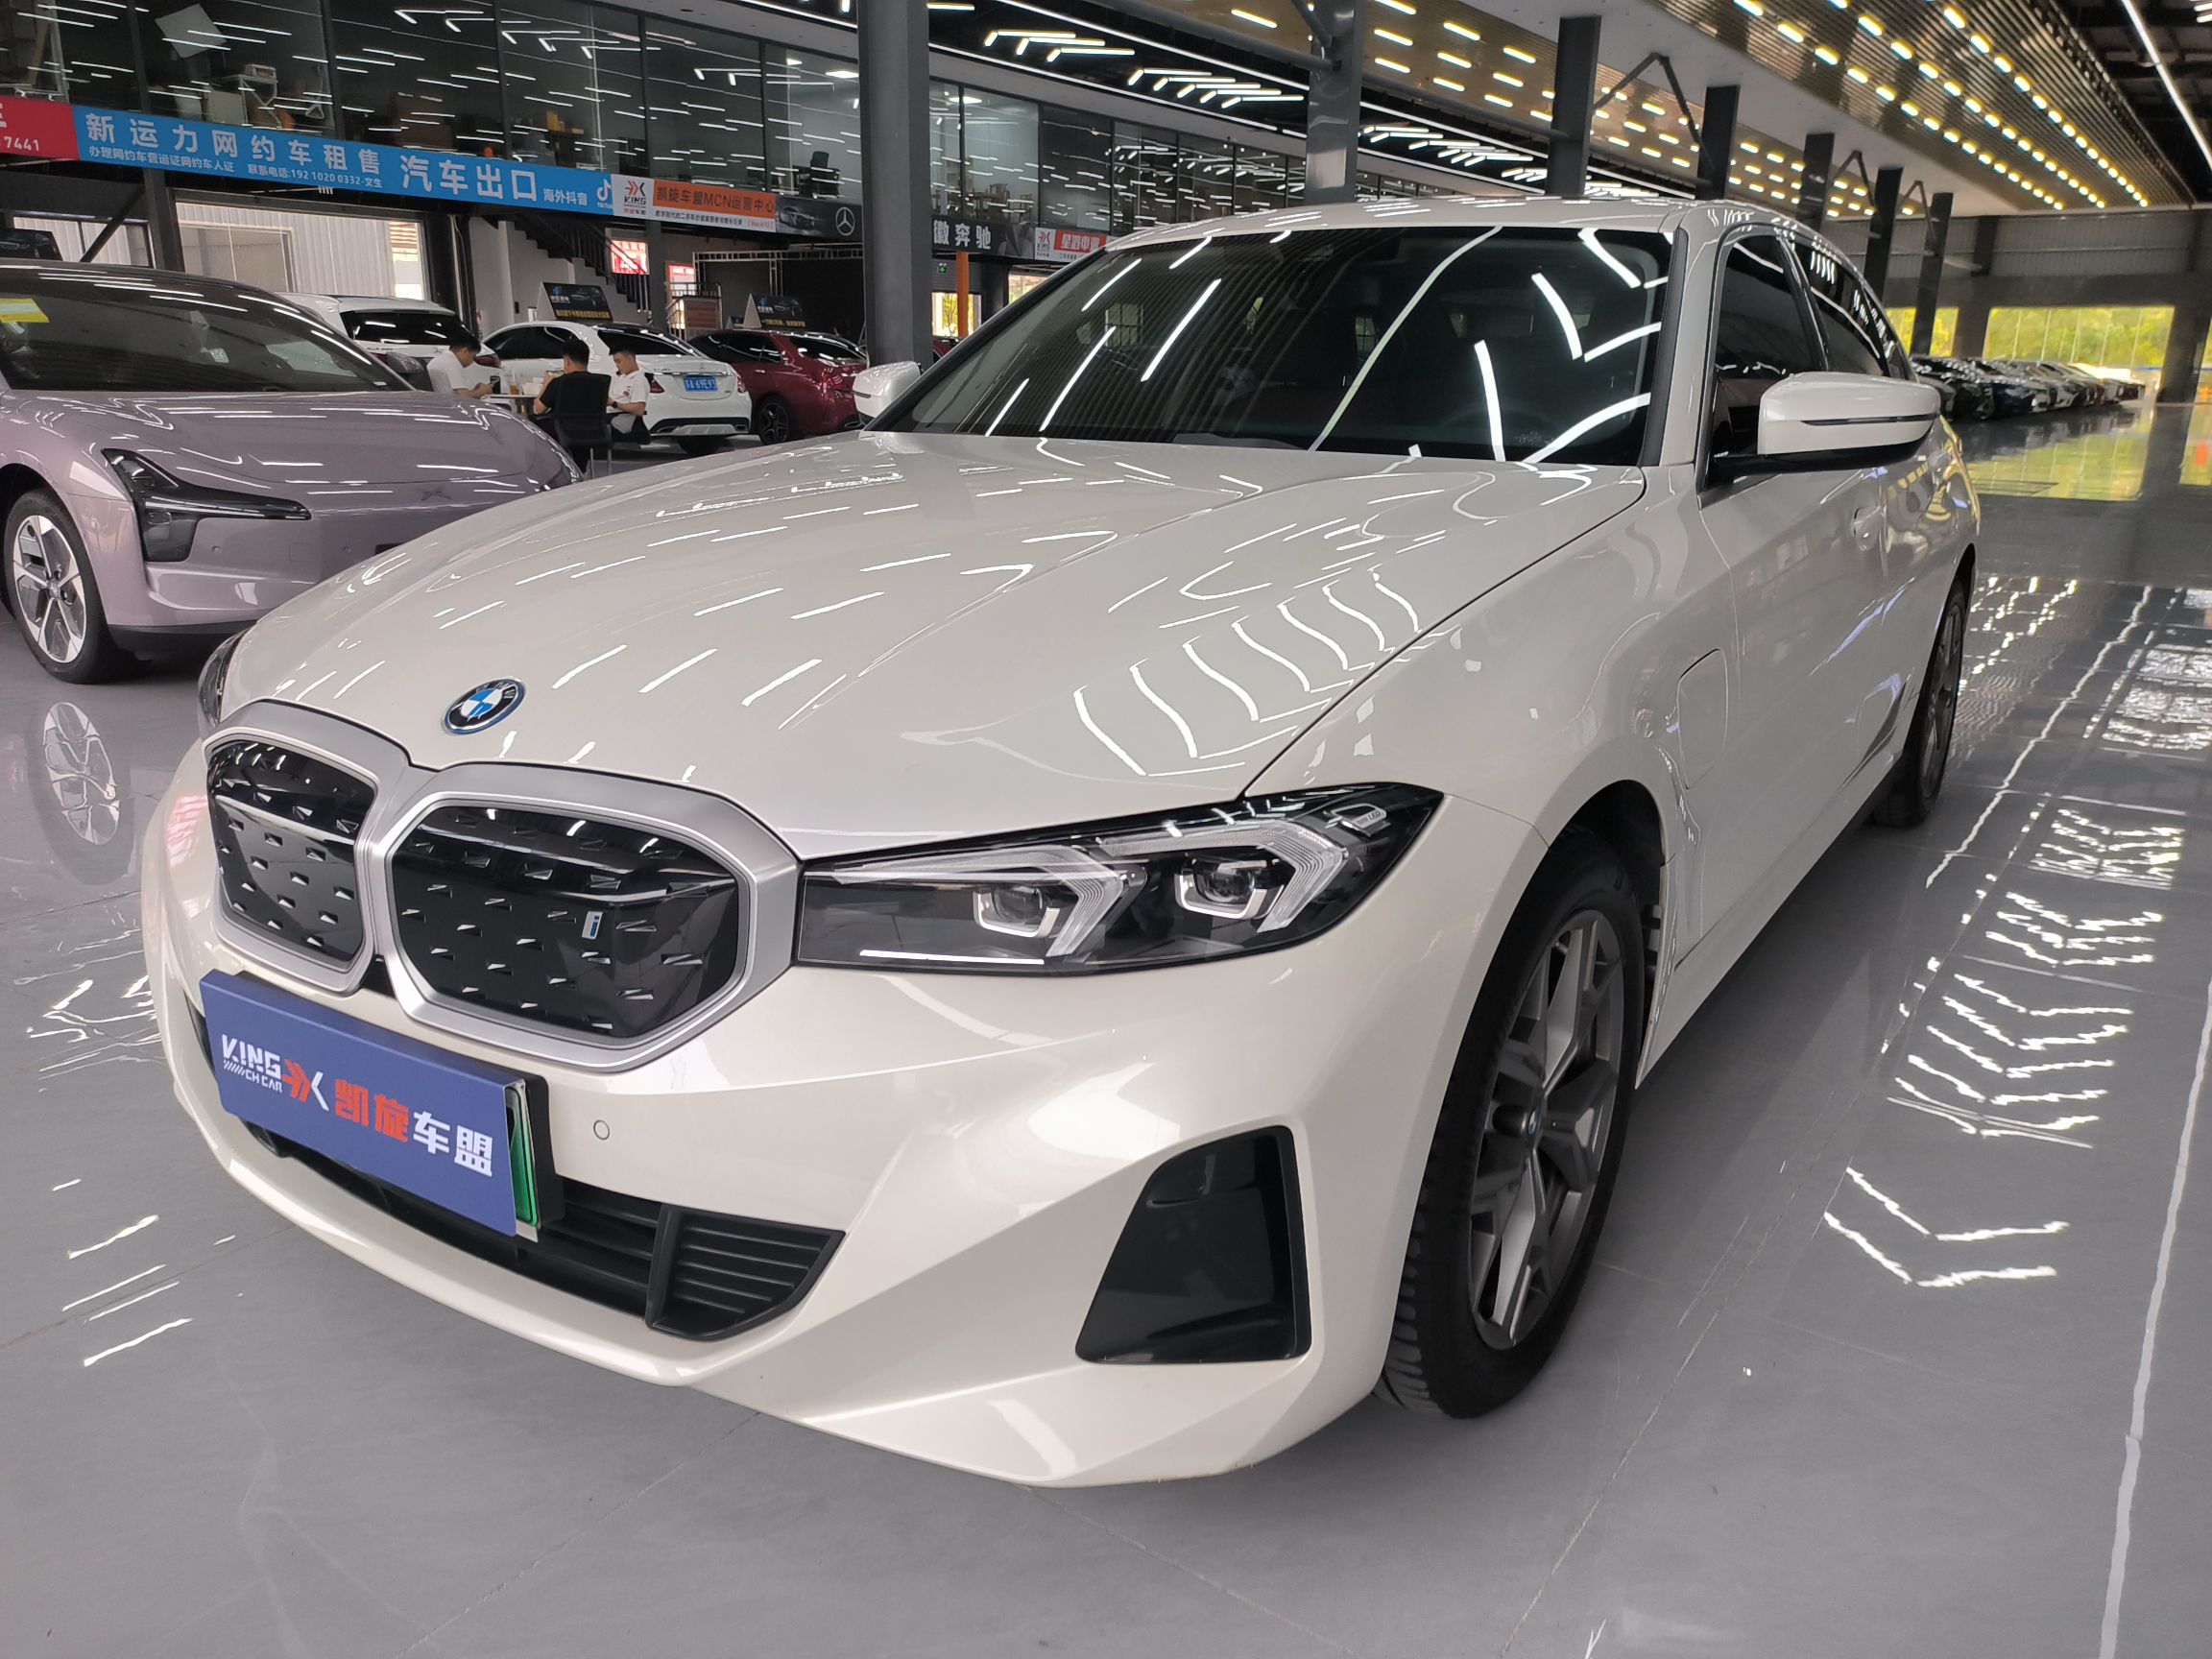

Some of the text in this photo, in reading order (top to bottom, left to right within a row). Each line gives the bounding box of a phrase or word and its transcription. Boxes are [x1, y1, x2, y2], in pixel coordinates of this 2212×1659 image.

[4, 135, 39, 152] 7441
[85, 113, 381, 175] 新运力网约车租售
[400, 155, 538, 202] 汽车出口
[543, 187, 589, 206] 海外抖音
[222, 1034, 282, 1078] KING
[245, 1069, 283, 1094] CH CAR
[334, 1078, 493, 1179] 凯旋车盟
